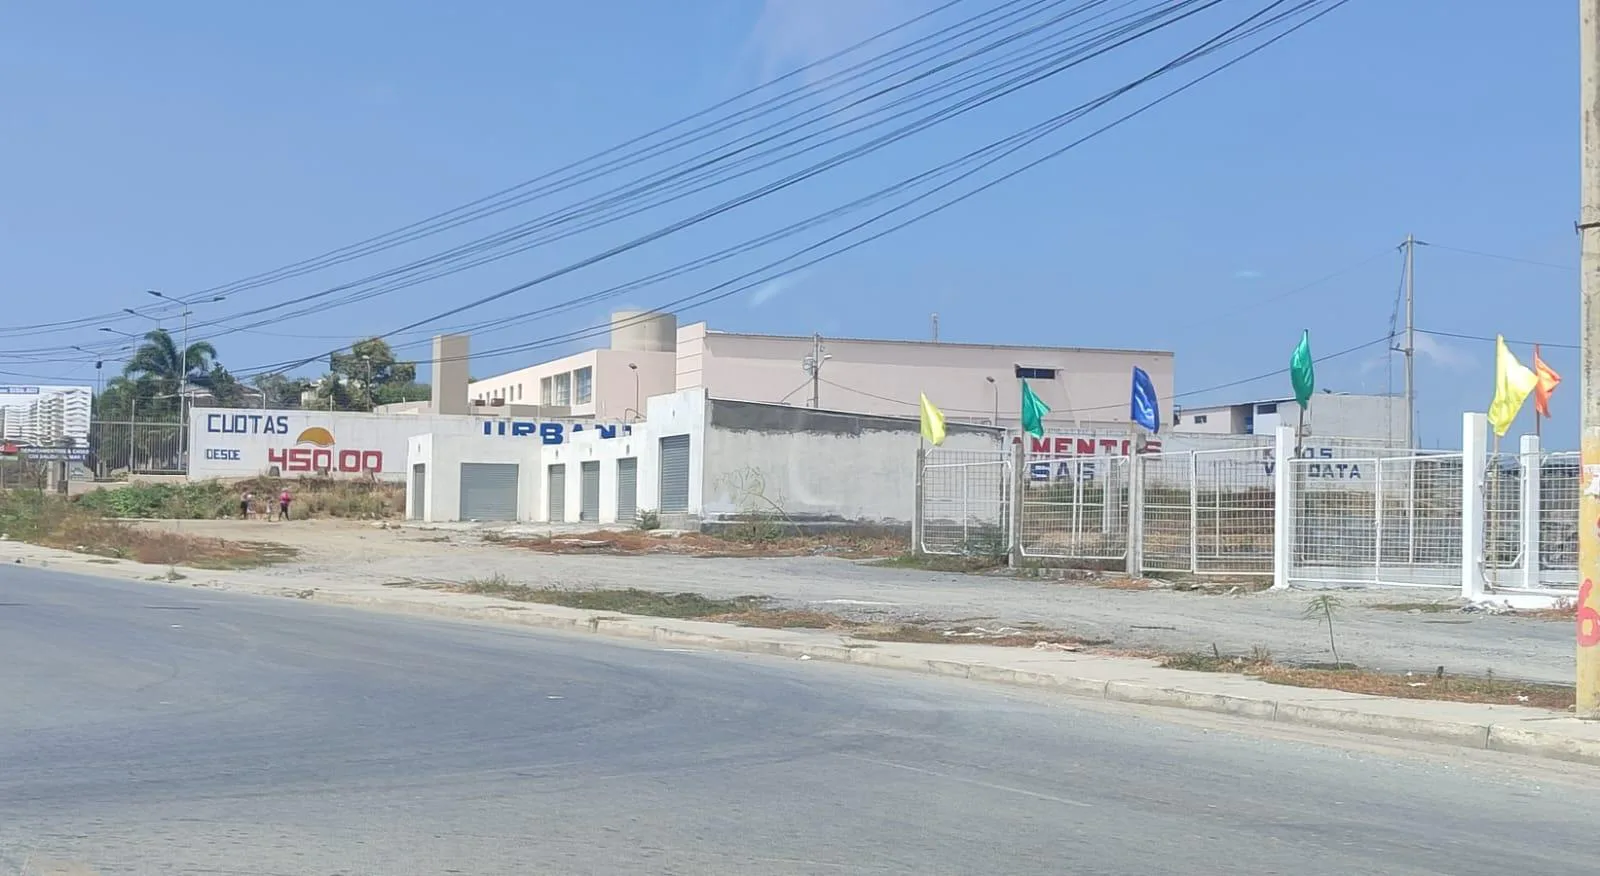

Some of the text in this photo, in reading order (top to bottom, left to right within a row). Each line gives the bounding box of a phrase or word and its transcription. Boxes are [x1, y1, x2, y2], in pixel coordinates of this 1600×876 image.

[207, 414, 289, 434] CUOTAS
[206, 449, 241, 461] DESDE
[268, 448, 384, 473] 450.00
